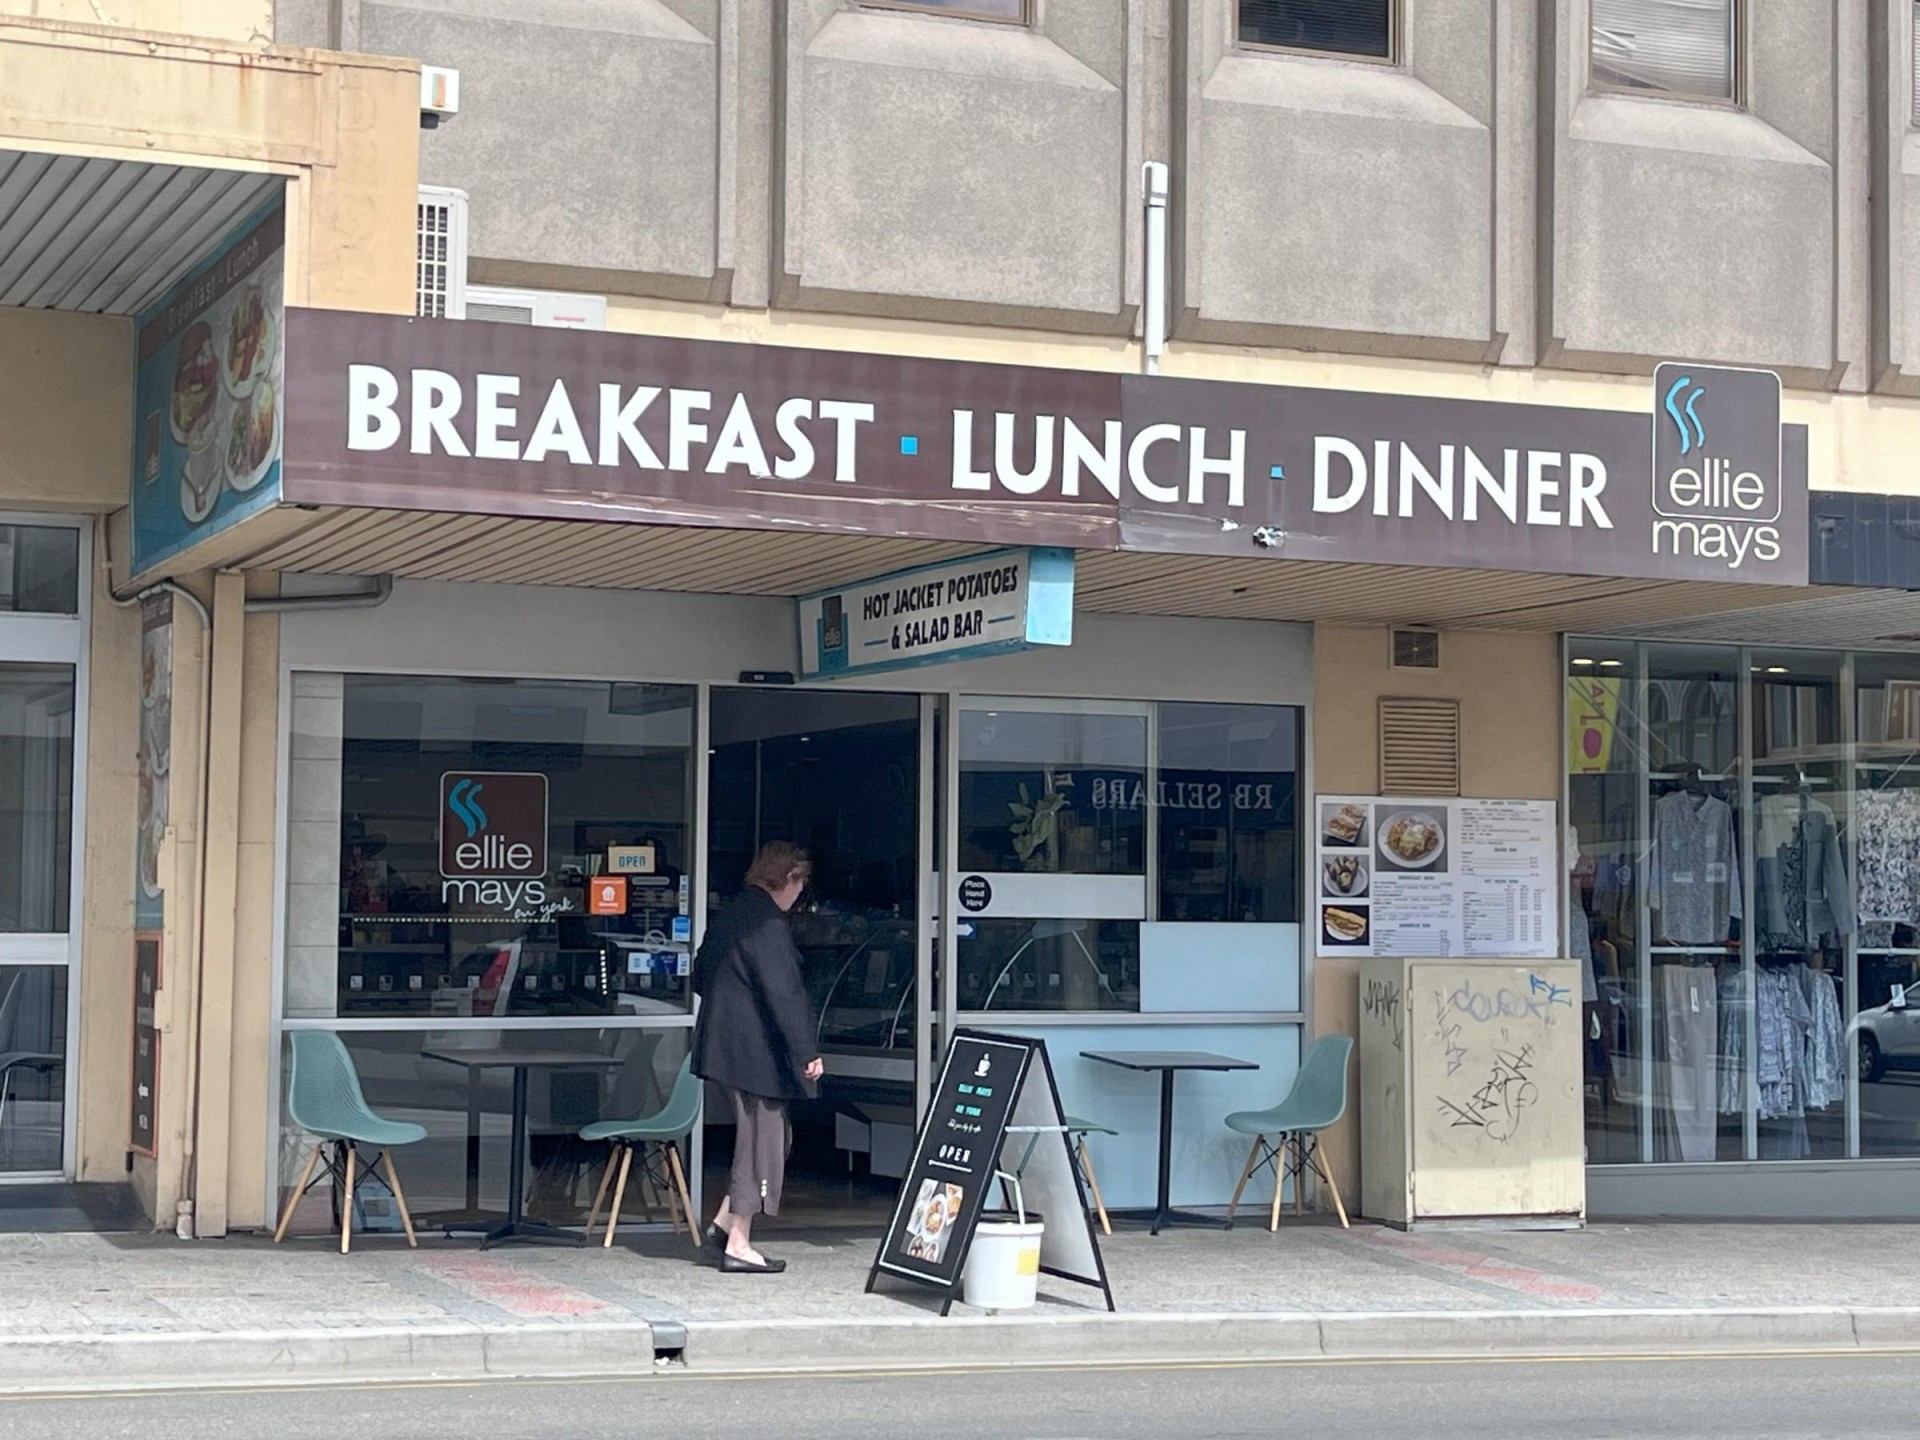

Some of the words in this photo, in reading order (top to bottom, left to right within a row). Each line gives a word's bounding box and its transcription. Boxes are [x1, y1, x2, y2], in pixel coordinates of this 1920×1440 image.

[348, 364, 875, 483] BREAKFAST
[951, 409, 1246, 507] LUNCH
[1313, 436, 1614, 530] DINNER
[1668, 458, 1766, 511] ellie
[1651, 521, 1782, 569] mays
[863, 592, 891, 620] HOT
[893, 581, 944, 614] JACKET
[947, 564, 1019, 604] POTATOES
[891, 625, 901, 650] &
[905, 619, 949, 648] SALAD
[954, 609, 983, 638] BAR
[455, 835, 533, 870] ellie
[618, 856, 647, 869] OPEN
[442, 880, 546, 911] mays
[939, 1144, 971, 1163] OPEN
